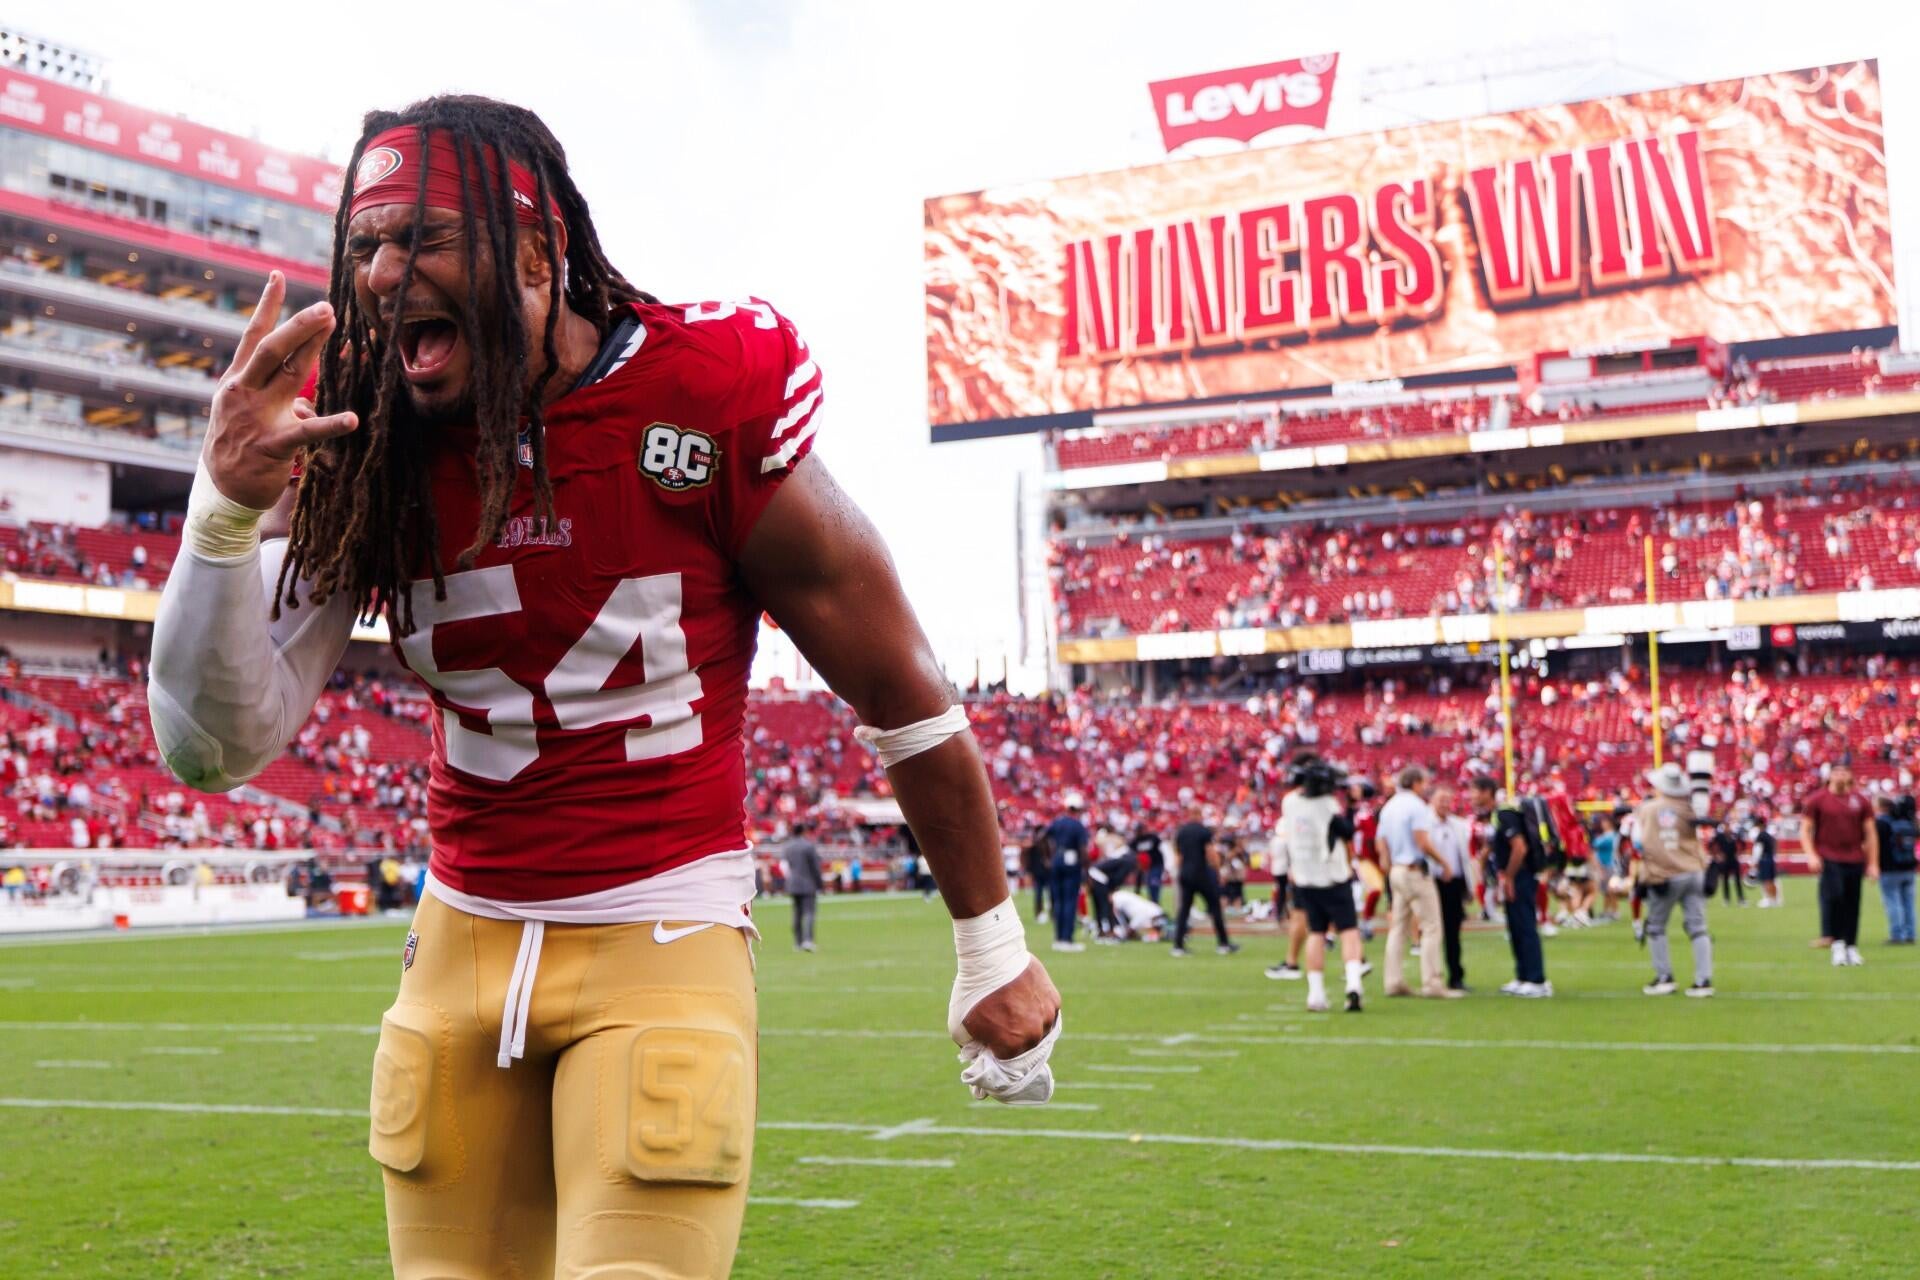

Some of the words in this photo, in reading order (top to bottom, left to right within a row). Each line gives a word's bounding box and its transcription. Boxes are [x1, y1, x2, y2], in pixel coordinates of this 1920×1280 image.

[1063, 178, 1439, 358] NINERS
[1467, 130, 1718, 290] WIN
[399, 564, 704, 782] 54
[640, 1046, 743, 1159] 54
